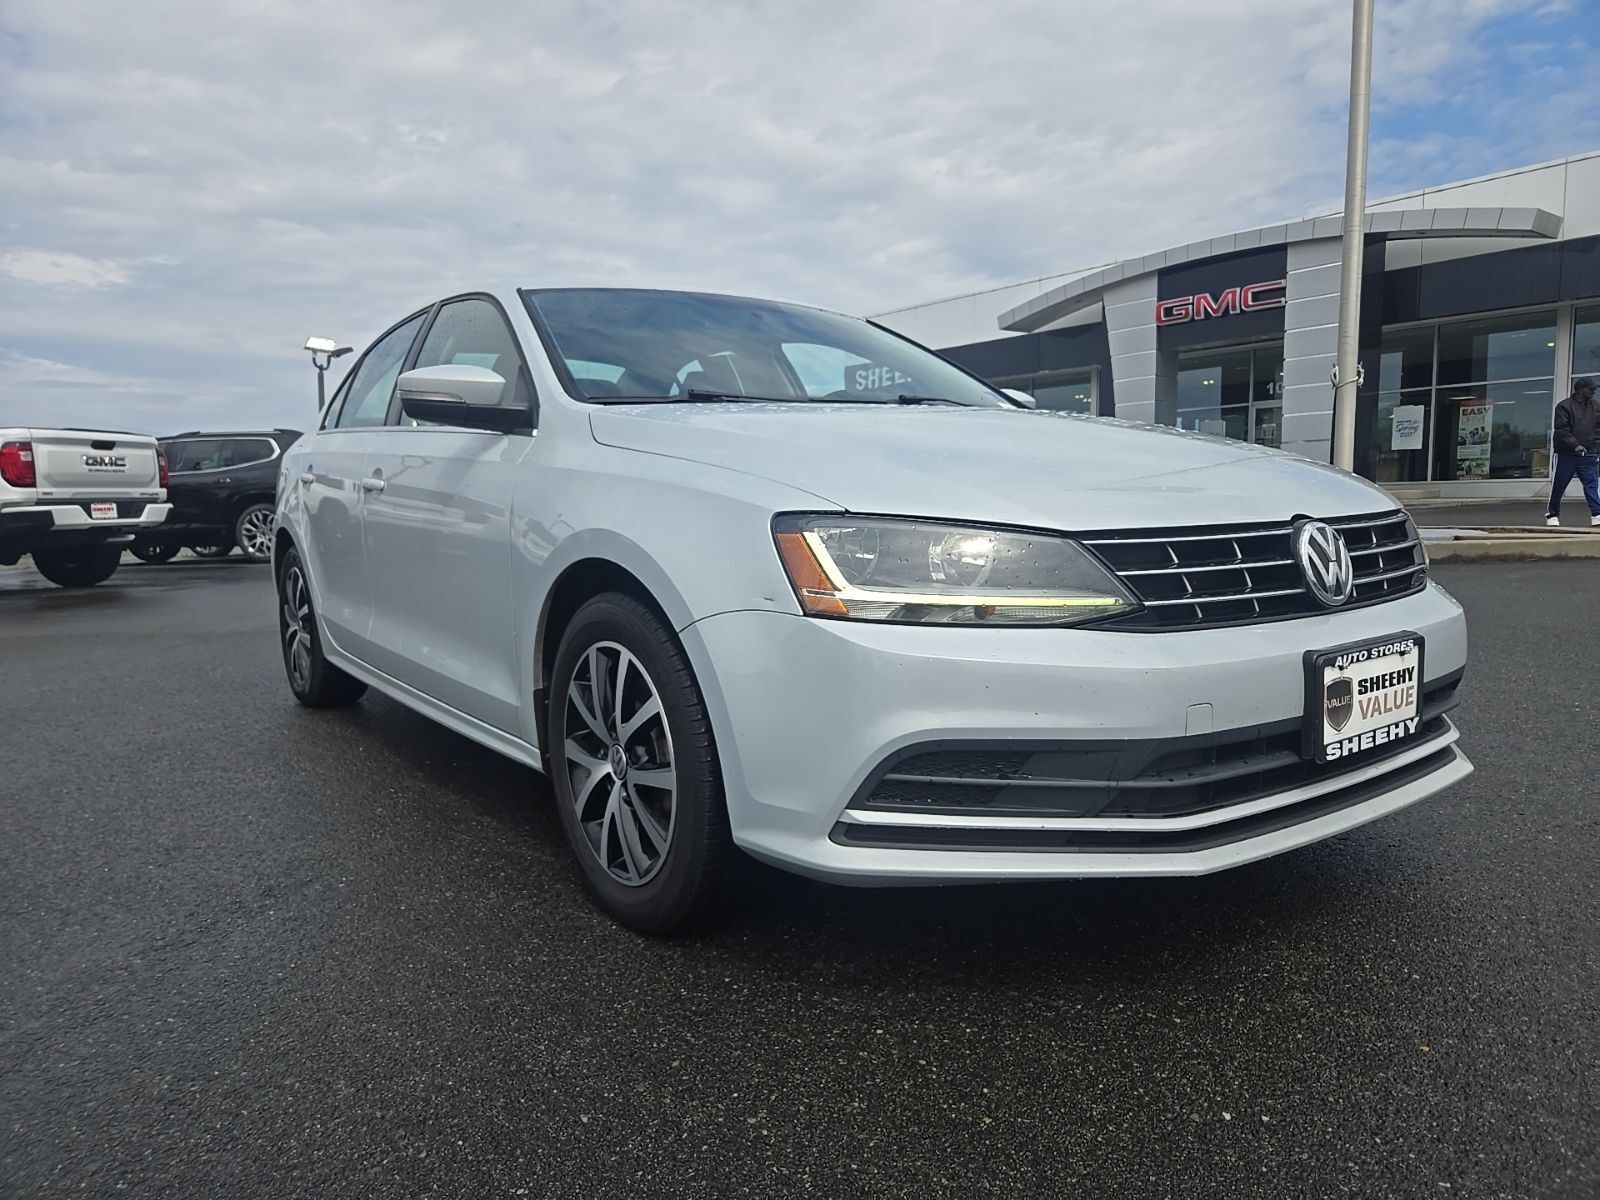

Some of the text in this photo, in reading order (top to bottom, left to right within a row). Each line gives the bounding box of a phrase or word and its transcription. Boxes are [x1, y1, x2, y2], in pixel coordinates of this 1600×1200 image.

[1155, 279, 1287, 326] GMC
[1462, 407, 1490, 416] EASY
[83, 455, 126, 467] GMC
[1335, 640, 1414, 667] AUTO STORES
[1358, 666, 1415, 695] SHEEHY
[1325, 695, 1352, 708] VALUE
[1358, 685, 1415, 720] VALUE
[1326, 717, 1420, 761] SHEEHY
